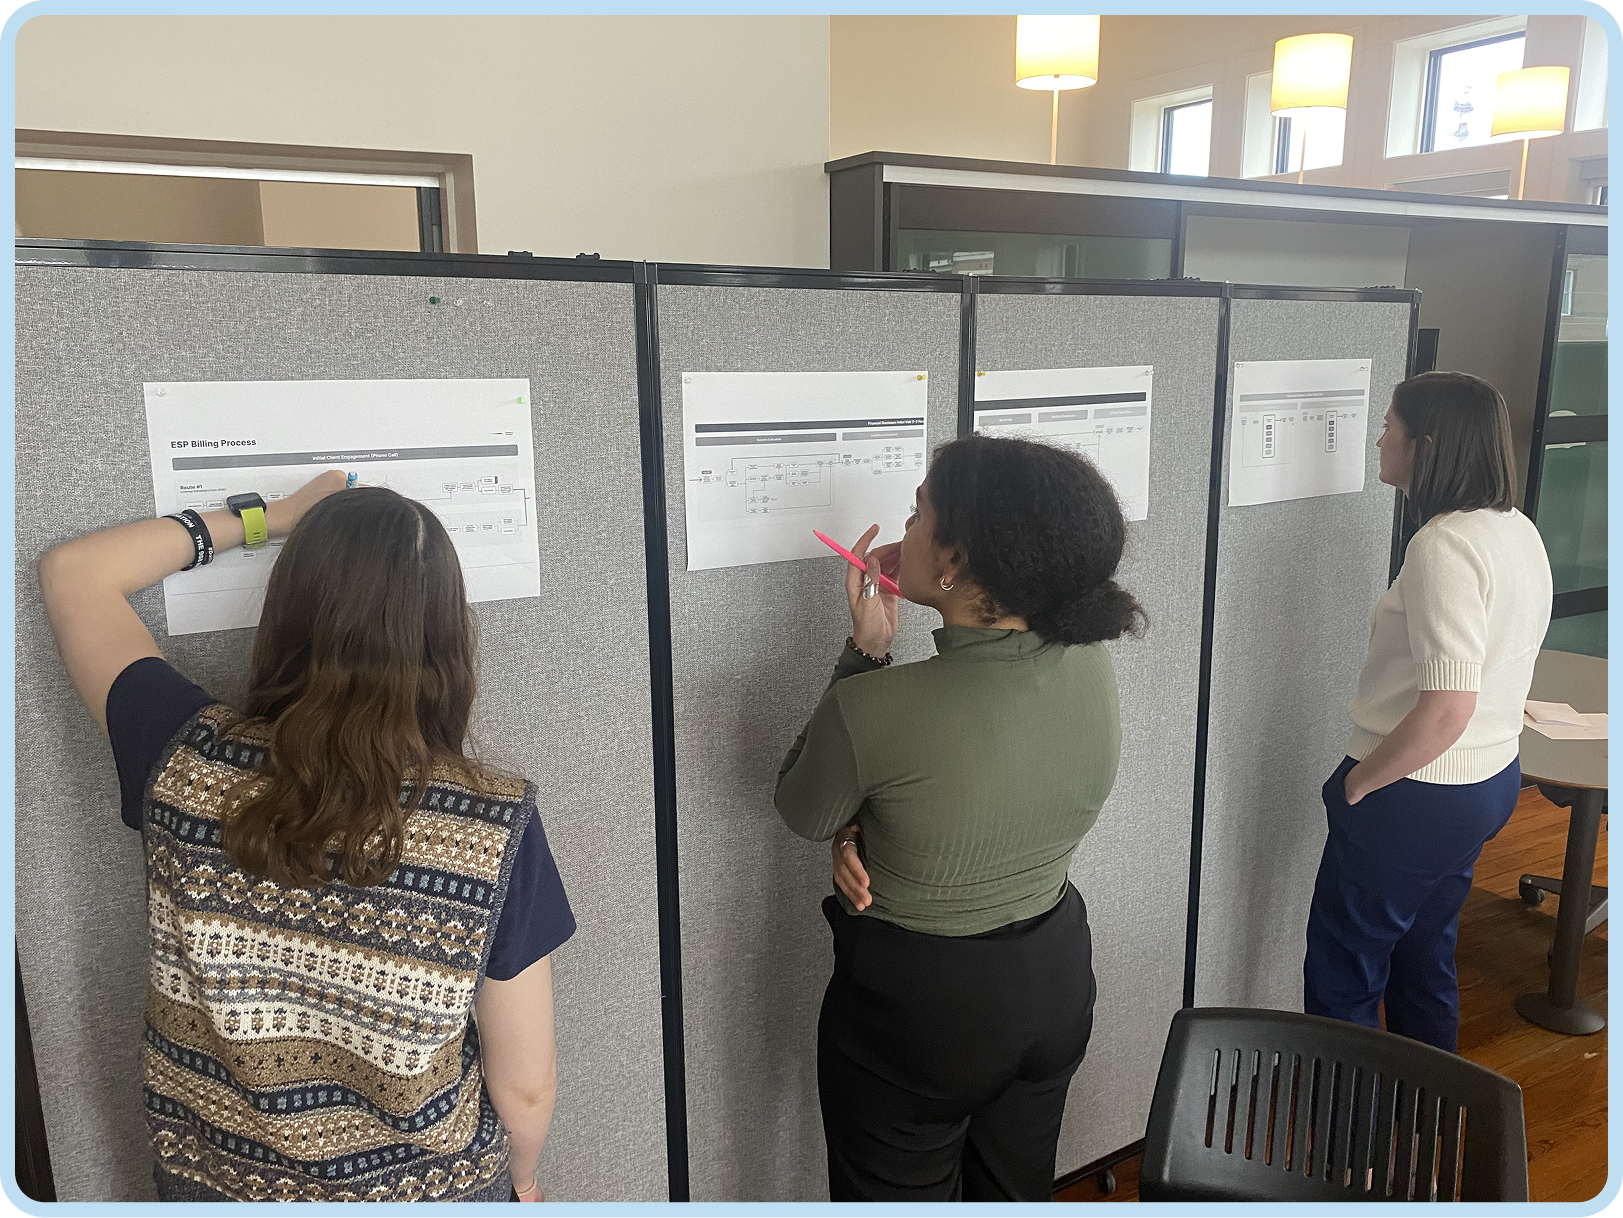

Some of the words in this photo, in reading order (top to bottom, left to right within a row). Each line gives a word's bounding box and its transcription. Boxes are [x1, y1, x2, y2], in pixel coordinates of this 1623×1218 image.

[171, 441, 189, 449] ESP
[191, 440, 219, 449] Billing
[221, 439, 257, 447] Process
[195, 534, 205, 551] THE
